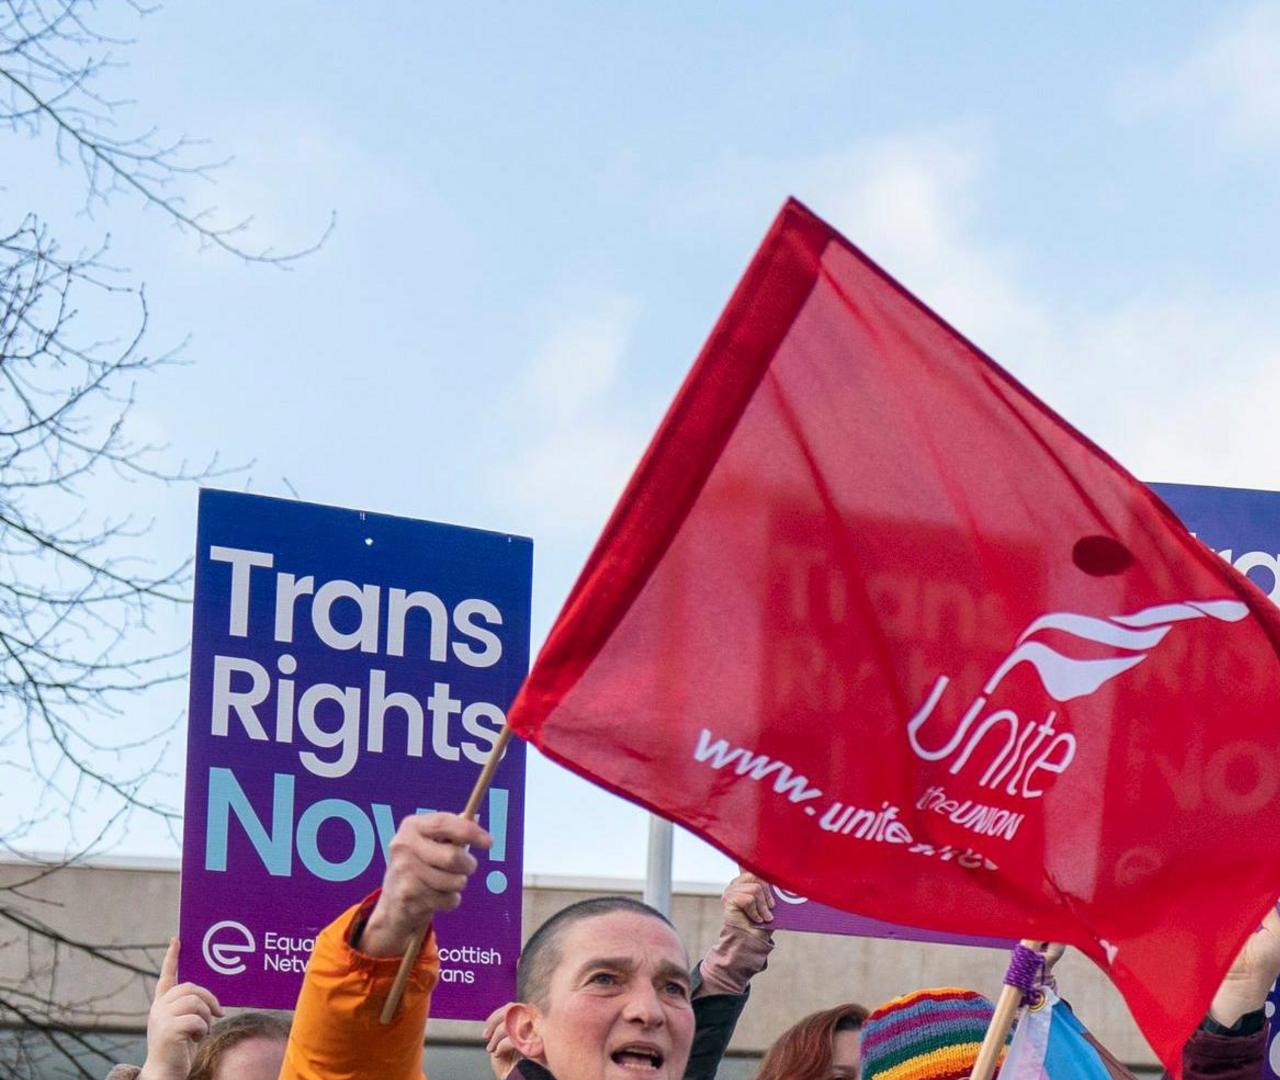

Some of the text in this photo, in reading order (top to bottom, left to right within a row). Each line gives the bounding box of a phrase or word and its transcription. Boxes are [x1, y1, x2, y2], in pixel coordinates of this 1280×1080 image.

[209, 545, 503, 668] Trans
[210, 654, 509, 778] Rights
[437, 946, 501, 966] cottish
[438, 968, 475, 983] rans
